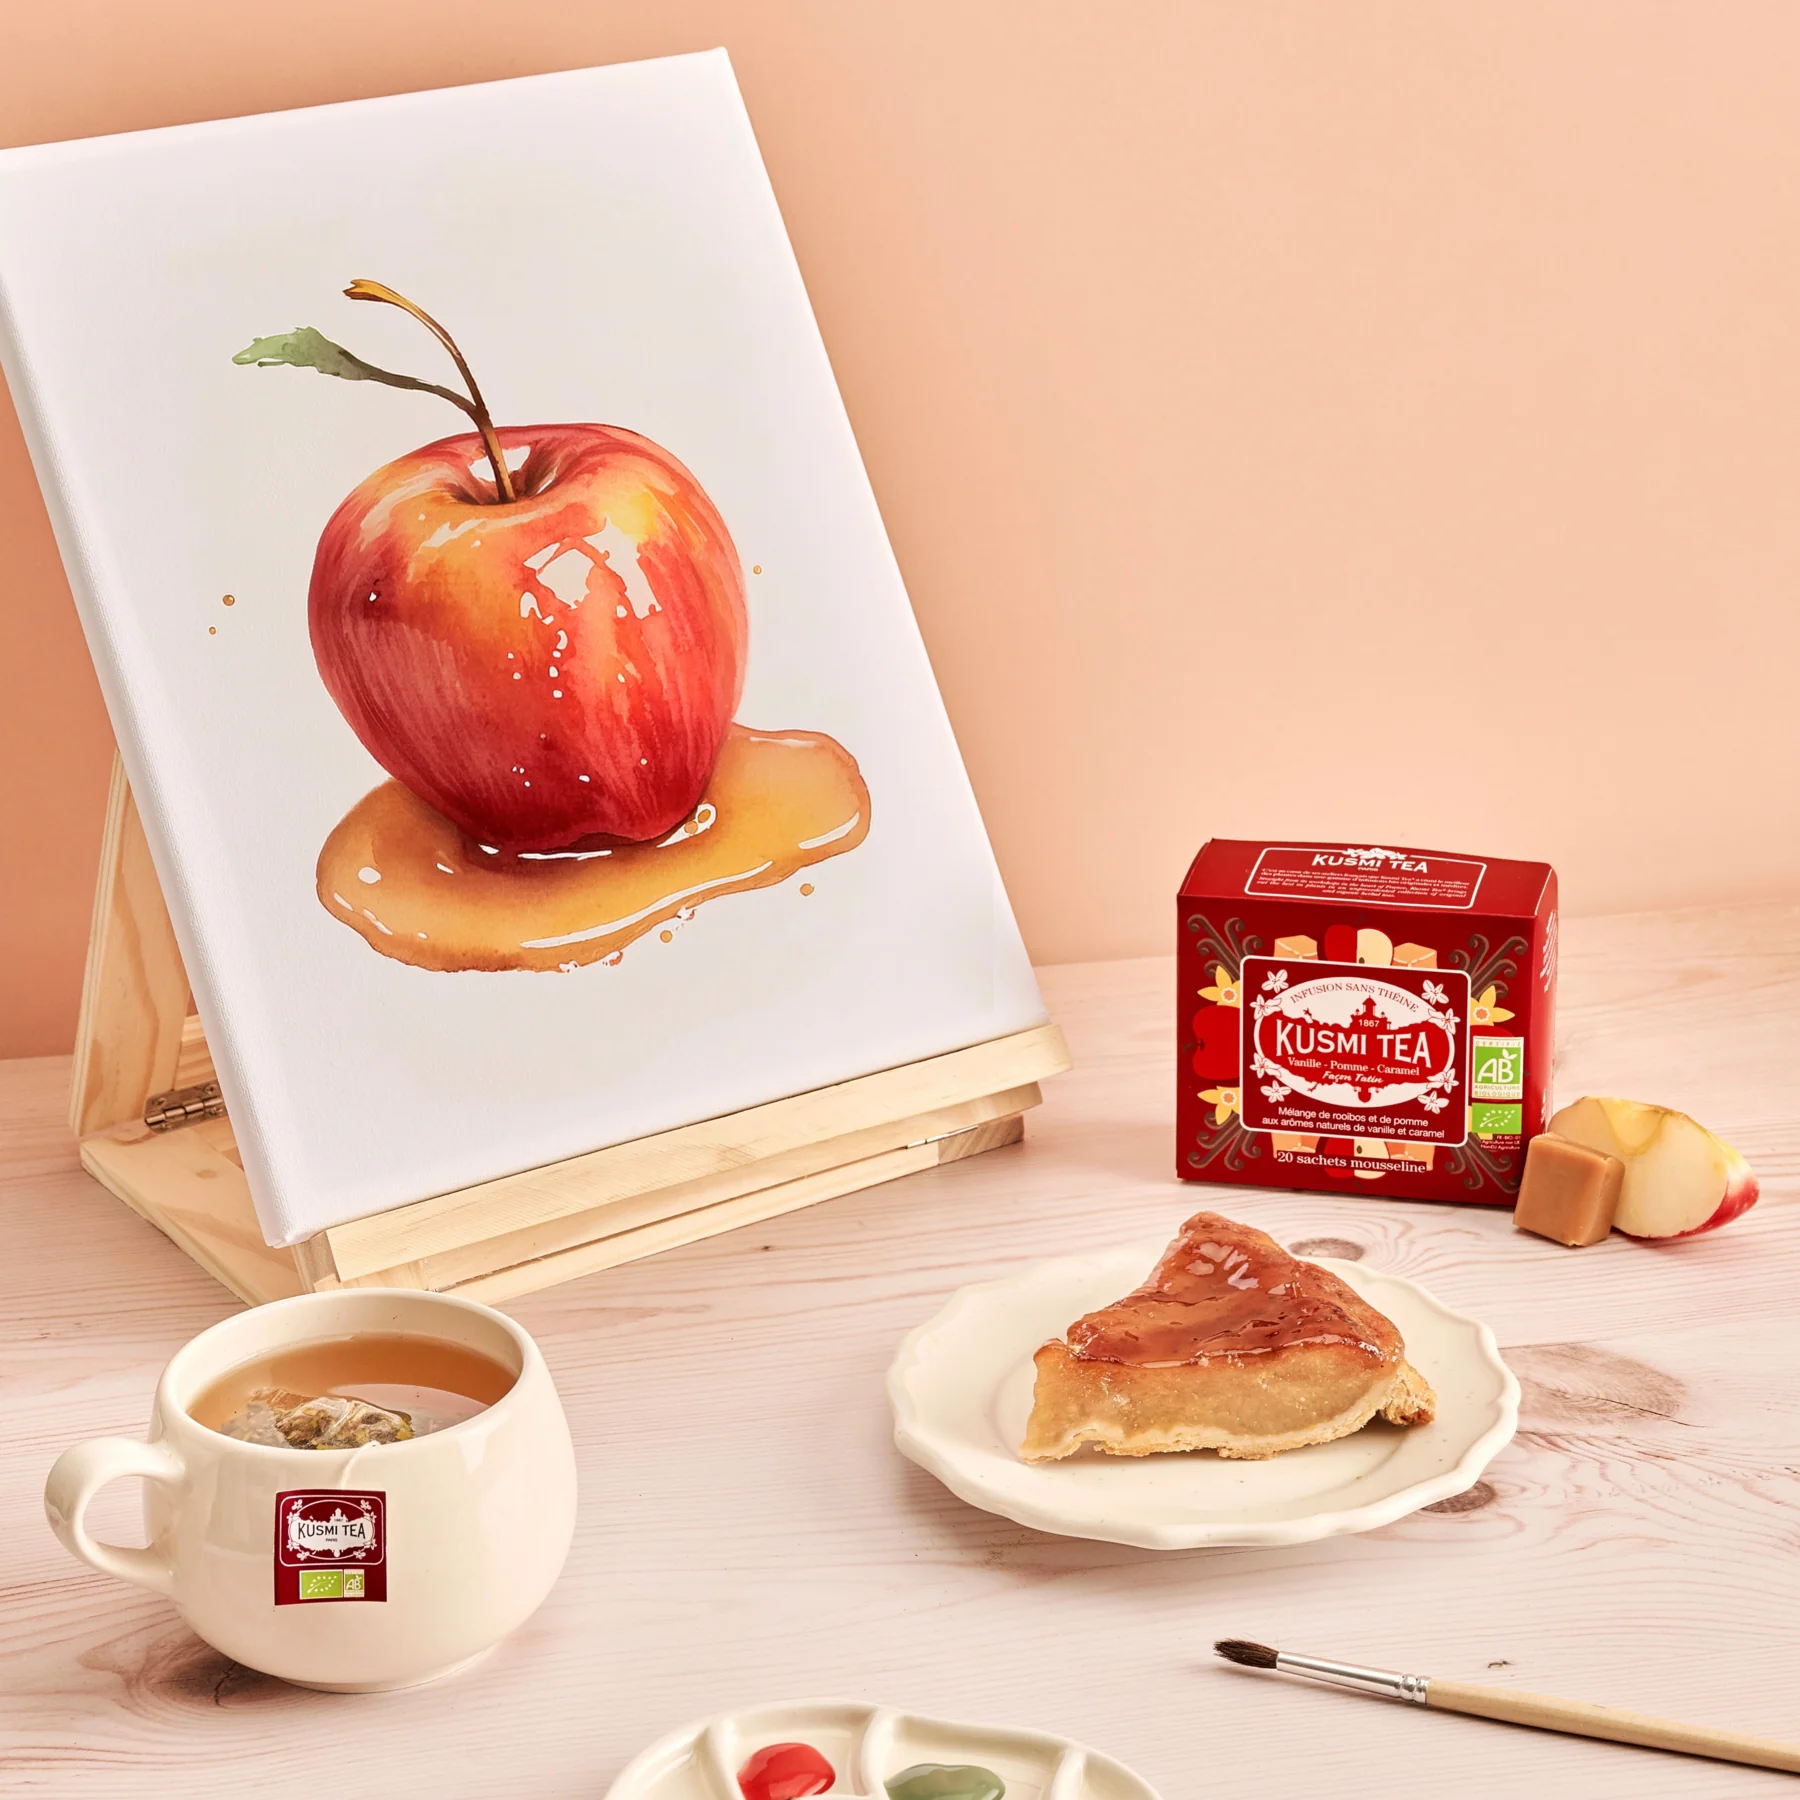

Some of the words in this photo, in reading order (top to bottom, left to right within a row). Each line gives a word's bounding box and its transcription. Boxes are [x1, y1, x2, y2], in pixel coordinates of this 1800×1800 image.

[1312, 854, 1382, 867] KUSMI
[1390, 860, 1428, 874] TEA
[1290, 982, 1343, 1004] INFUSION
[1346, 982, 1375, 994] SANS
[1378, 986, 1419, 1013] THÉINE
[1359, 1019, 1380, 1027] 1867
[1276, 1019, 1366, 1057] KUSMI
[1377, 1031, 1432, 1068] TEA
[1288, 1057, 1321, 1069] Vanille
[1330, 1060, 1368, 1072] Pomme
[1377, 1064, 1420, 1076] Caramel
[1477, 1058, 1514, 1083] AB
[1322, 1071, 1352, 1084] Façon
[1354, 1073, 1383, 1084] Tatin
[1278, 1107, 1316, 1121] Mélange
[1319, 1110, 1330, 1119] de
[1332, 1112, 1366, 1122] rooibos
[1368, 1114, 1378, 1123] et
[1380, 1114, 1392, 1124] de
[1394, 1118, 1428, 1128] pomme
[1281, 1117, 1314, 1128] arômes
[1316, 1120, 1351, 1131] naturels
[1353, 1123, 1365, 1132] de
[1368, 1124, 1395, 1135] vanille
[1397, 1126, 1407, 1135] et
[1408, 1127, 1445, 1138] caramel
[1277, 1152, 1293, 1163] 20
[1297, 1153, 1347, 1168] sachets
[1351, 1160, 1426, 1173] mousseline
[298, 1522, 338, 1539] KUSMI
[342, 1522, 366, 1539] TEA
[346, 1578, 362, 1590] AB
